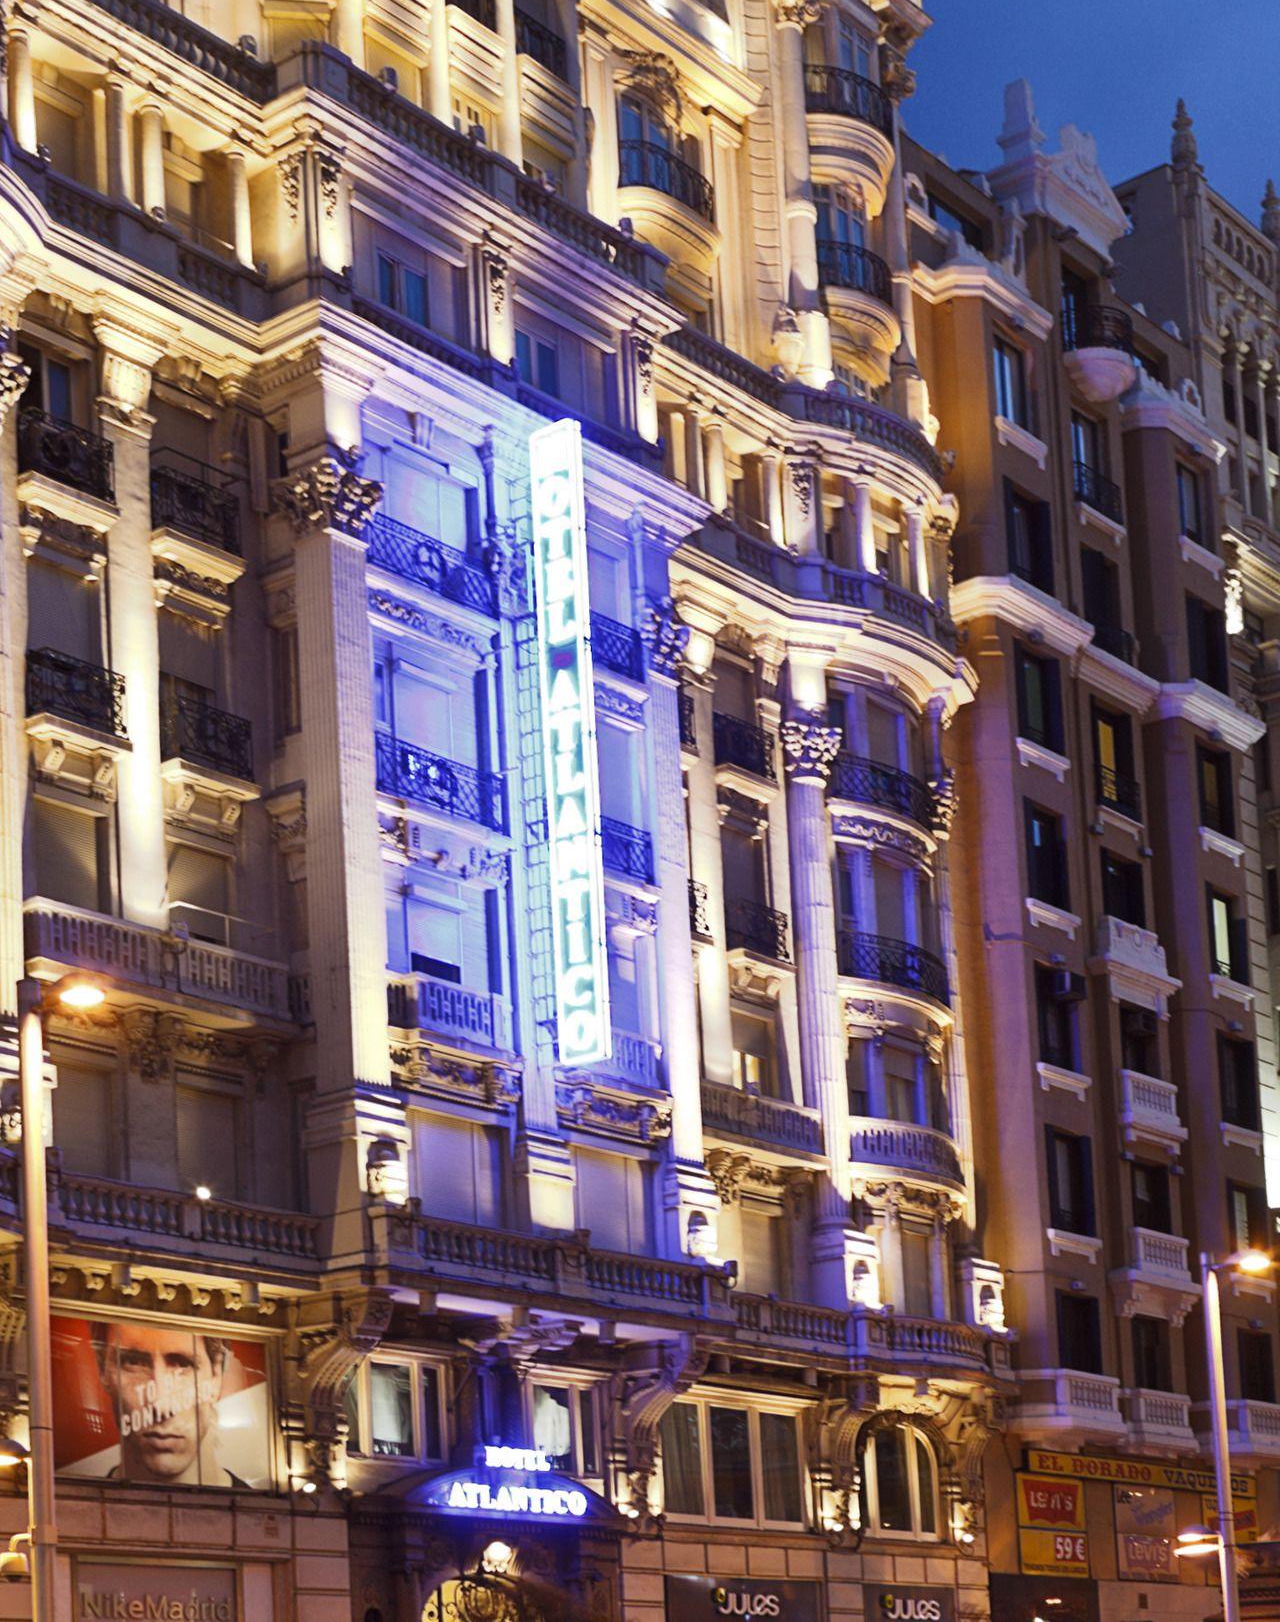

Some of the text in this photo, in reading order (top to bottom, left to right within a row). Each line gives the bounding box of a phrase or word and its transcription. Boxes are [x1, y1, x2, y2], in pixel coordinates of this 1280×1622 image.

[535, 434, 579, 646] OTEL
[1036, 1453, 1249, 1493] EL DORADO VAQUEOS
[448, 1481, 588, 1517] ATLANTICO
